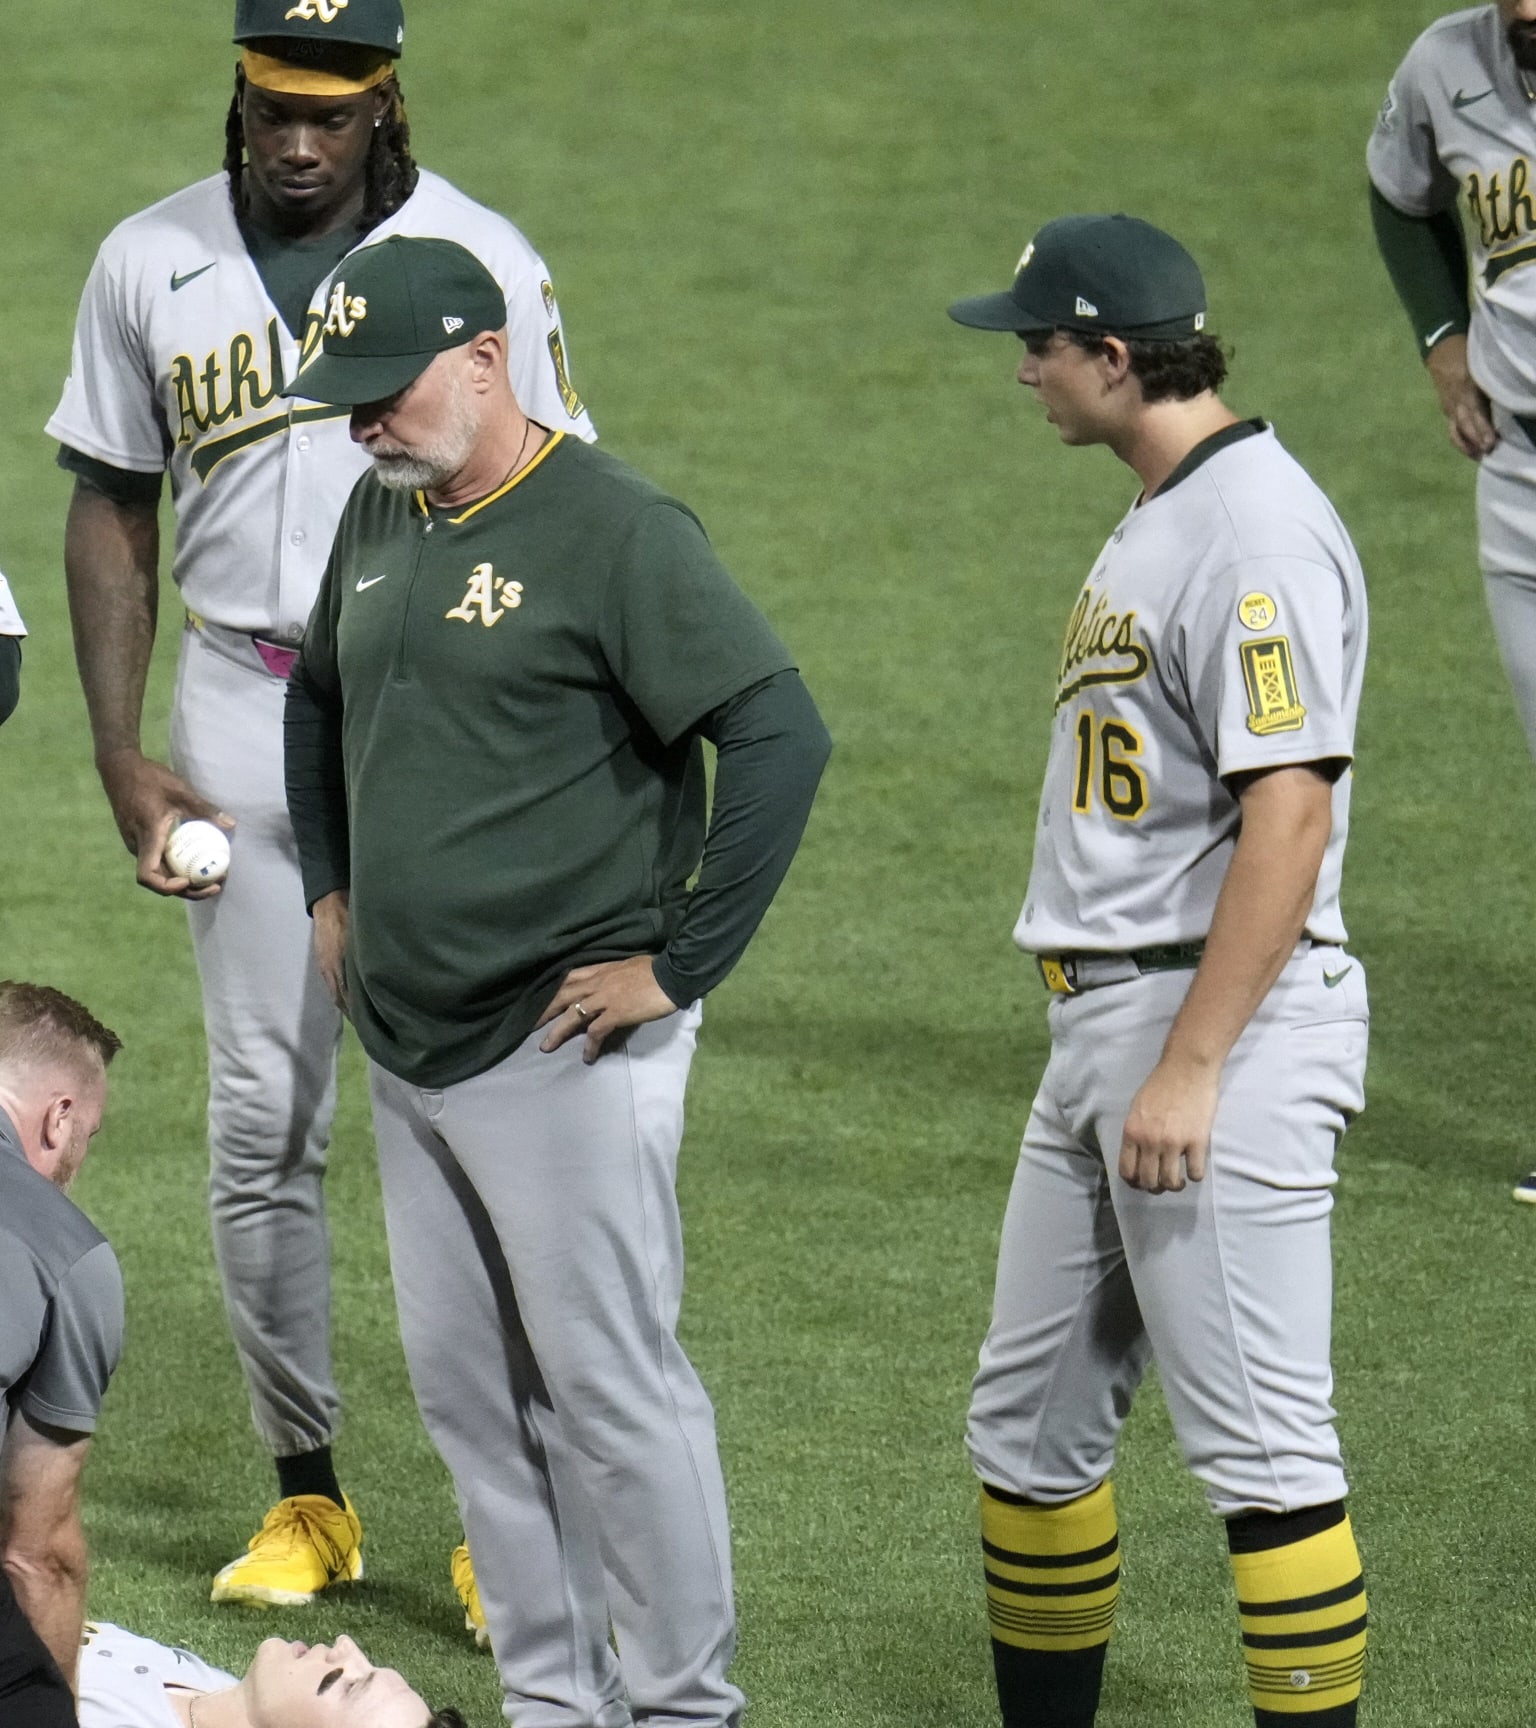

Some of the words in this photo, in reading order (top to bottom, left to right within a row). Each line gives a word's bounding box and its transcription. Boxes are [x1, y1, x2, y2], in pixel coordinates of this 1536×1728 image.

[323, 281, 367, 338] A's
[445, 562, 524, 628] A's
[1249, 606, 1267, 625] 24
[1072, 709, 1151, 823] 16
